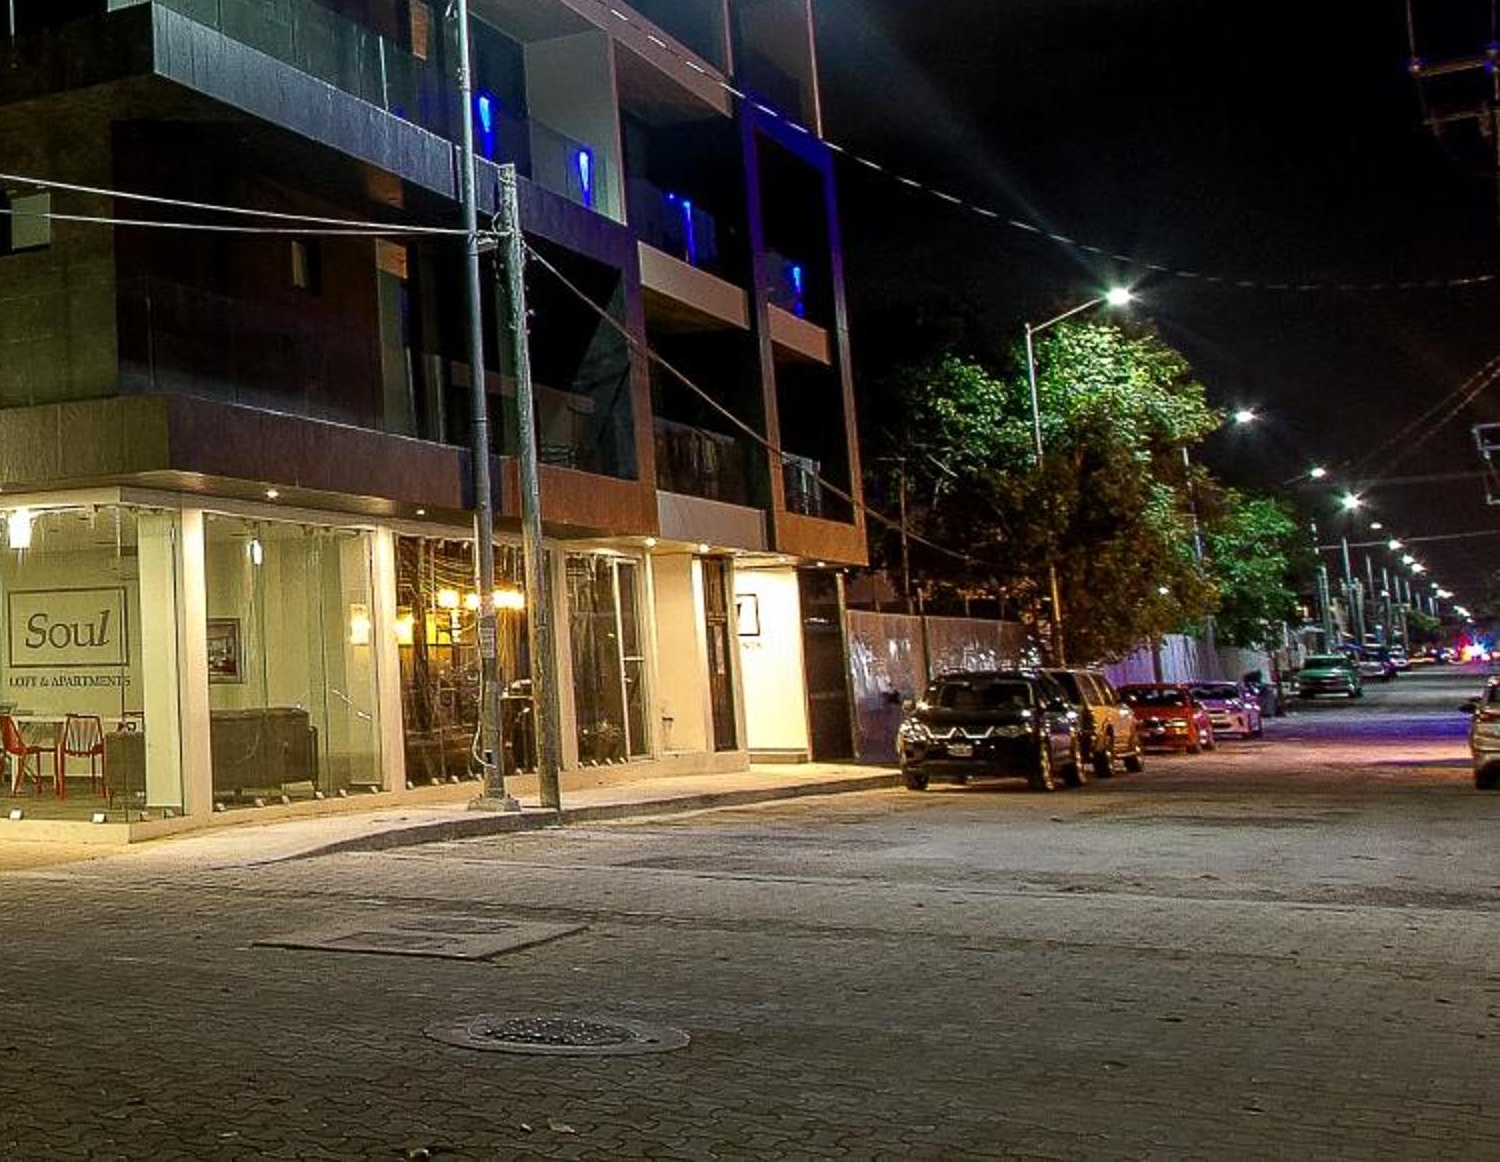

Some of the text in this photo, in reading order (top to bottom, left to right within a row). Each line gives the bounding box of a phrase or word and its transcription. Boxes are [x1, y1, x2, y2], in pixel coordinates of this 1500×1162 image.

[24, 609, 111, 649] Soul
[9, 674, 131, 687] LOFT & APARTMENTS
